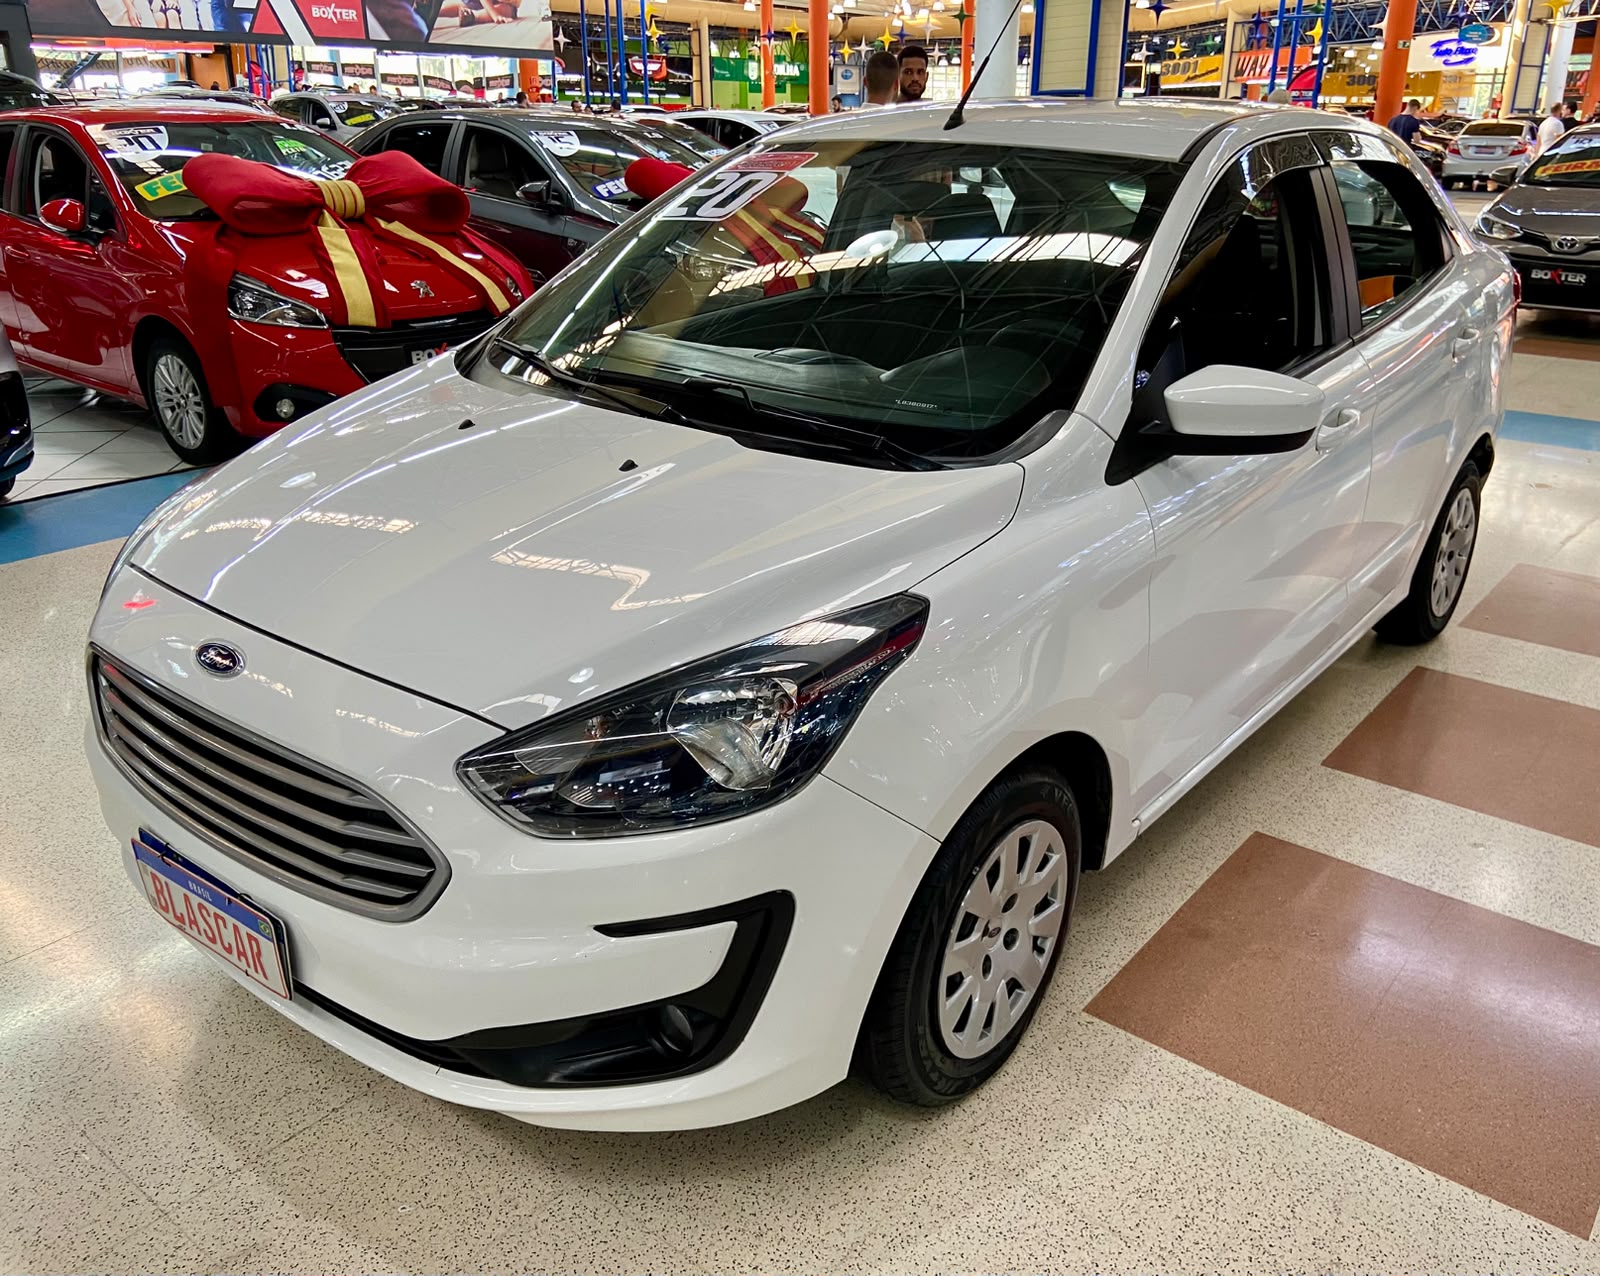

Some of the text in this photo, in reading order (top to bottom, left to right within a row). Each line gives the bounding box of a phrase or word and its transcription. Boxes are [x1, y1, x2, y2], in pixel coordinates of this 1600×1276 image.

[311, 3, 358, 24] BOXTER
[1161, 60, 1198, 75] 3001
[1234, 54, 1270, 77] WAY
[662, 171, 778, 218] 20
[1531, 268, 1586, 284] BOXTER
[188, 880, 213, 902] BRASIL
[150, 871, 269, 981] BLASCAR
